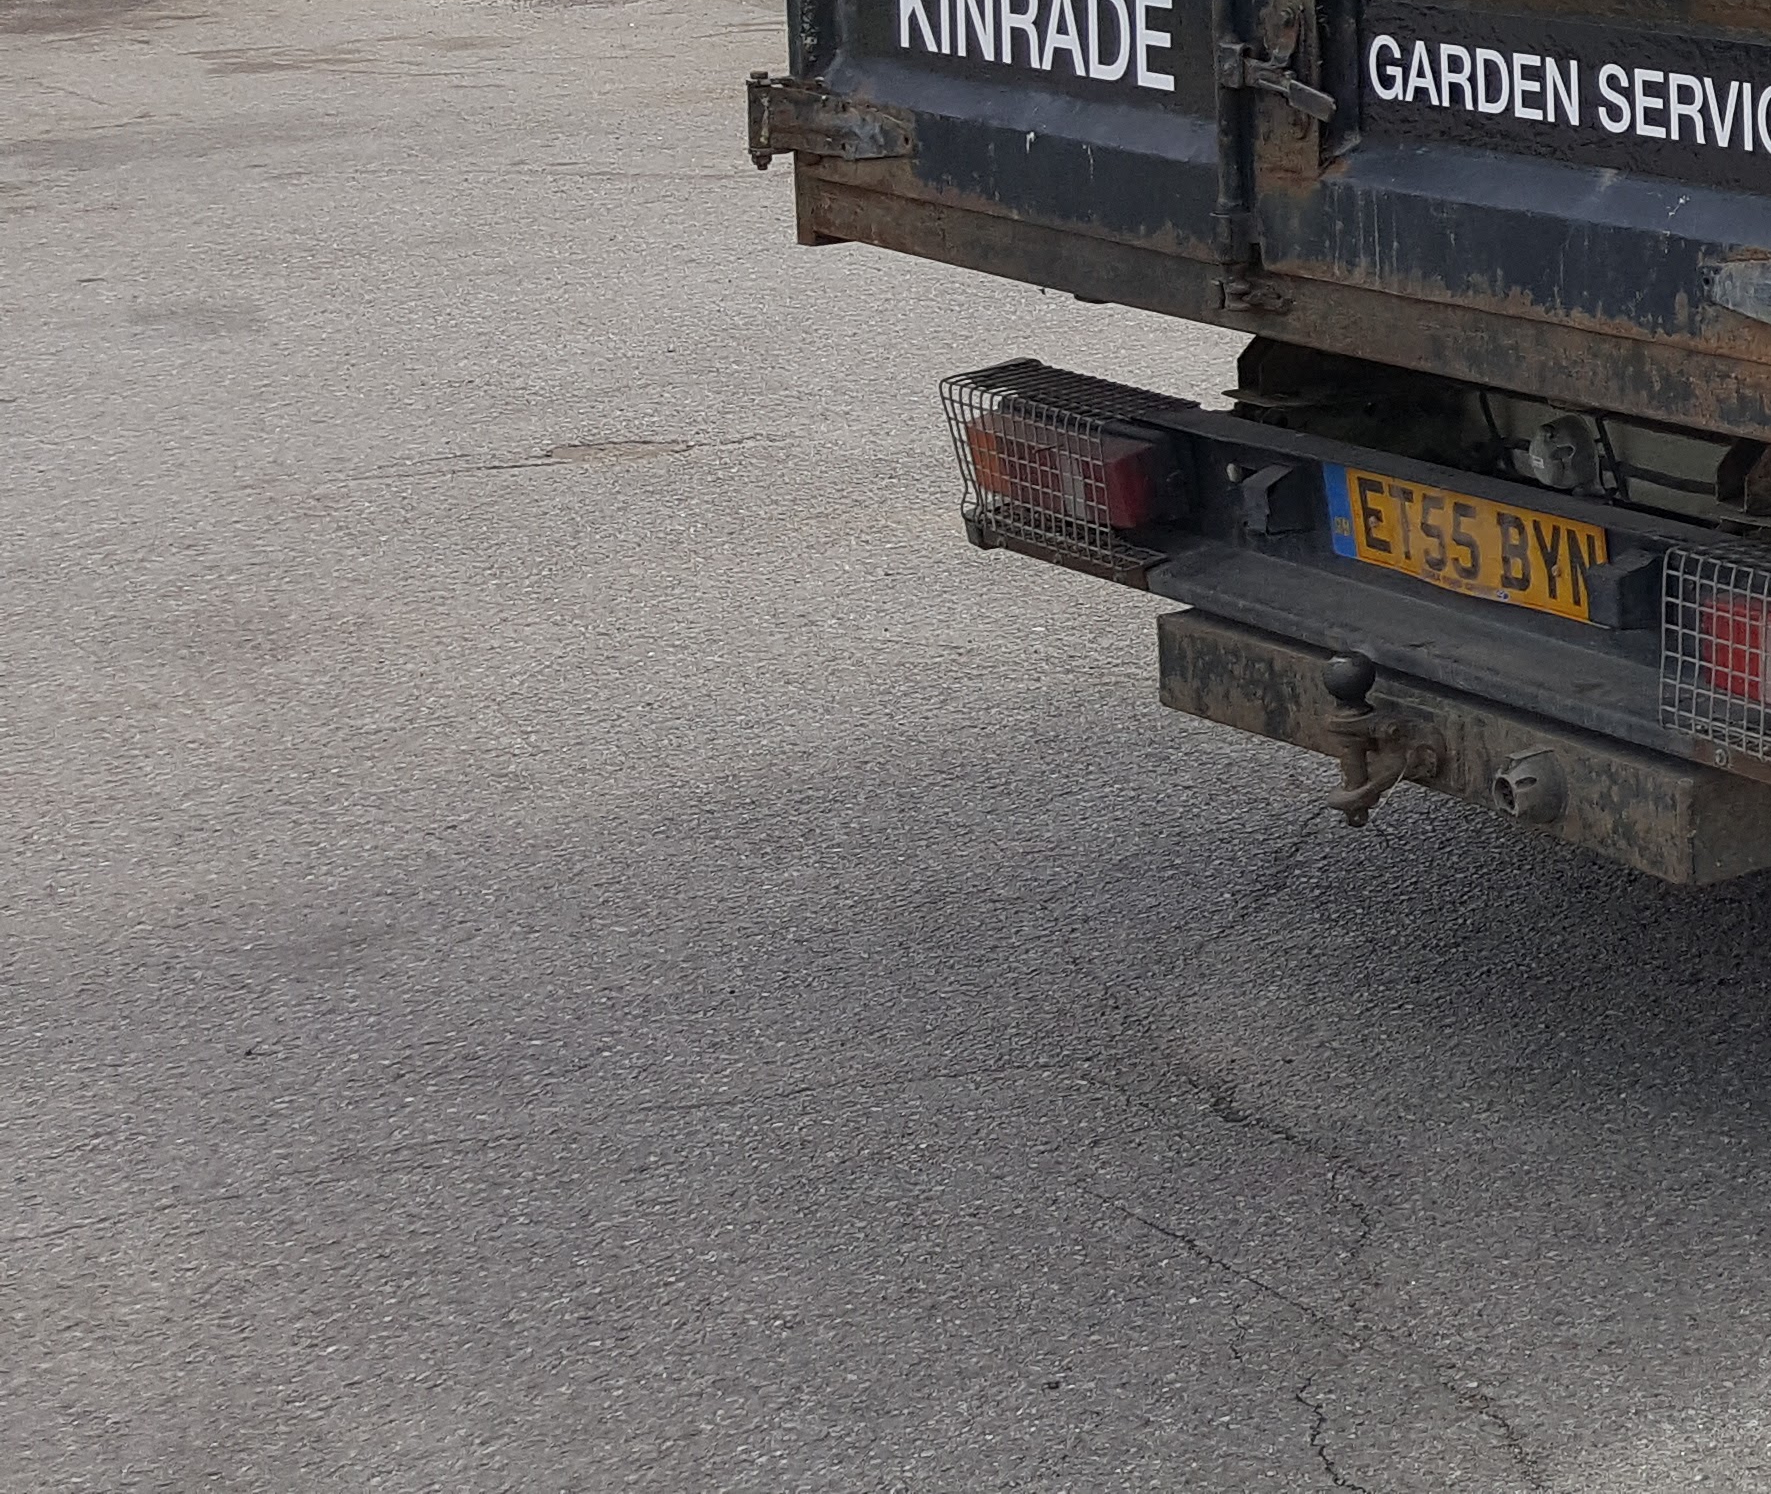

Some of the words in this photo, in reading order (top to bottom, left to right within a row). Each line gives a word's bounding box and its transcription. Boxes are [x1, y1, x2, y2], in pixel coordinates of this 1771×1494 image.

[1370, 35, 1579, 125] GARDEN
[1358, 476, 1481, 580] ET55
[1497, 512, 1595, 607] BYN
